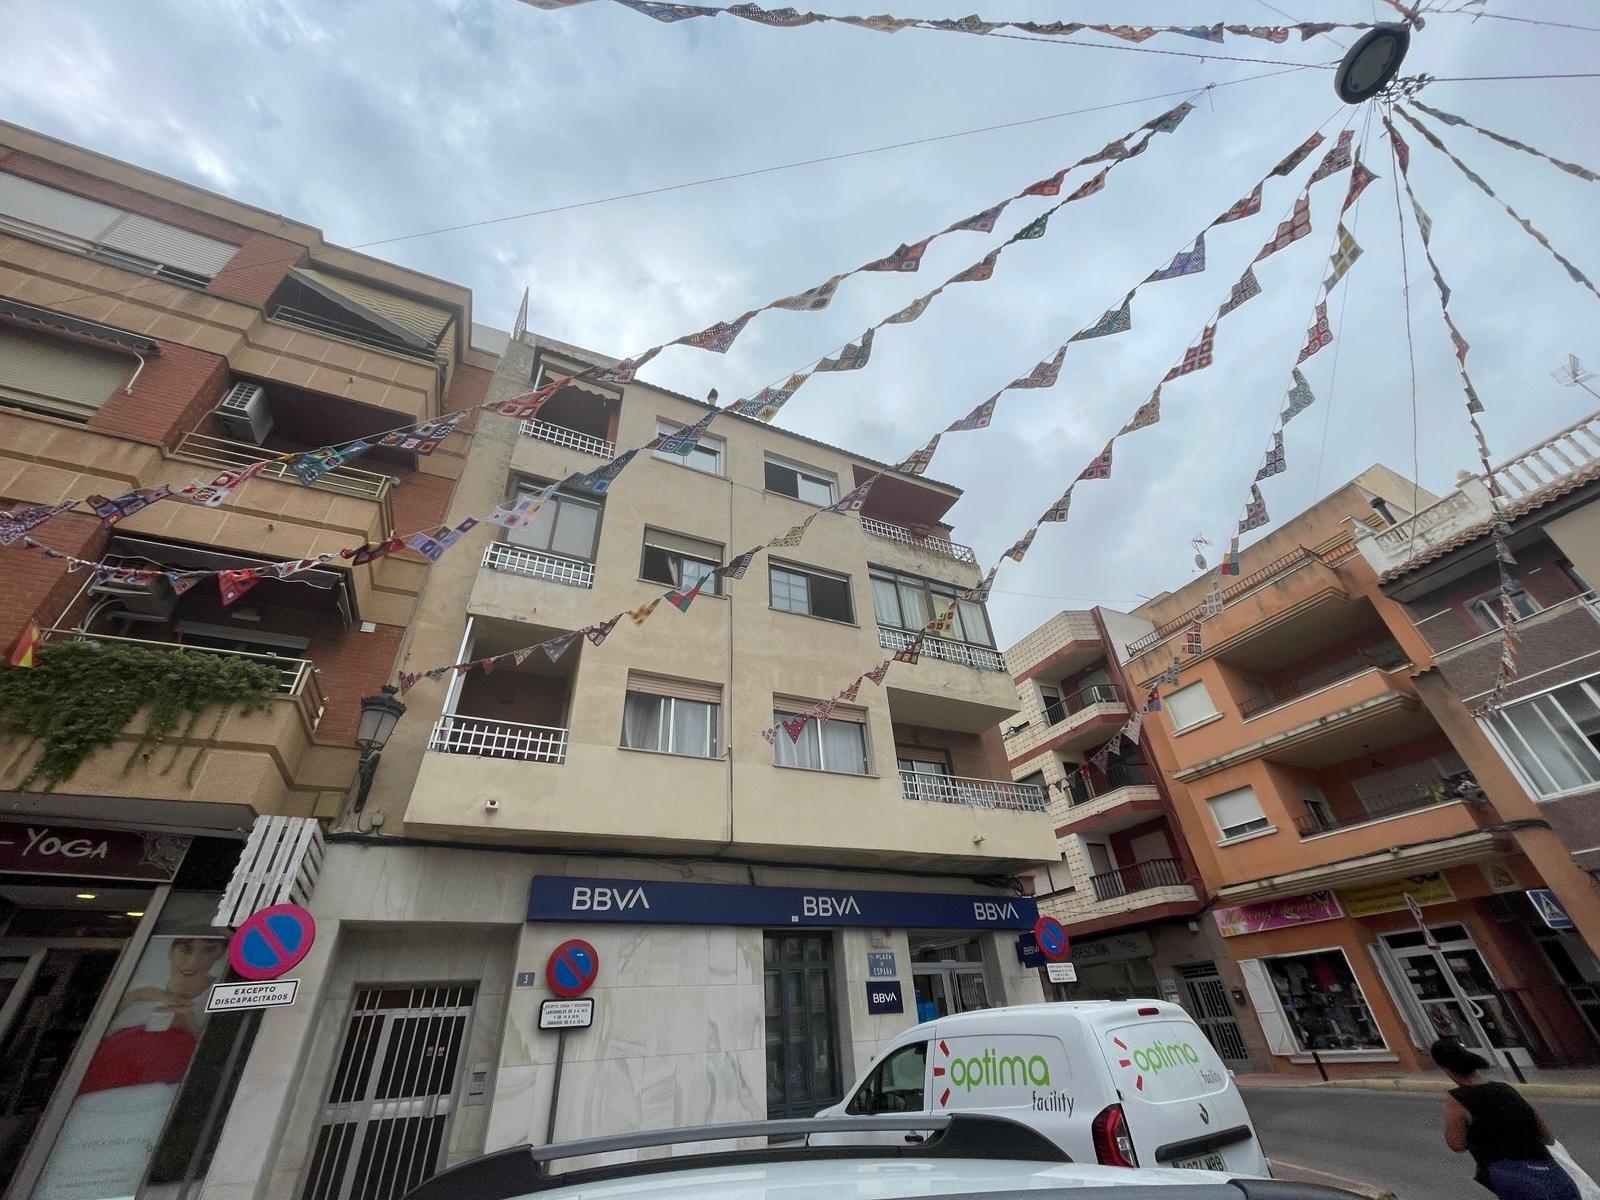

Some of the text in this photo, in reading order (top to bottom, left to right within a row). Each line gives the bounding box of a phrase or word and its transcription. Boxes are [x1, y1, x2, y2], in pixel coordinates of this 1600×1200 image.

[22, 828, 108, 859] YOGA
[572, 886, 650, 911] BBVA
[803, 896, 861, 917] BBVA
[973, 902, 1020, 920] BBVA
[215, 993, 288, 1006] DISCAPACITADOS
[234, 986, 276, 995] EXCEPTO
[872, 992, 897, 1003] BBVA
[1133, 1040, 1199, 1075] optima
[950, 1048, 1050, 1093] optima
[1032, 1090, 1075, 1118] facility
